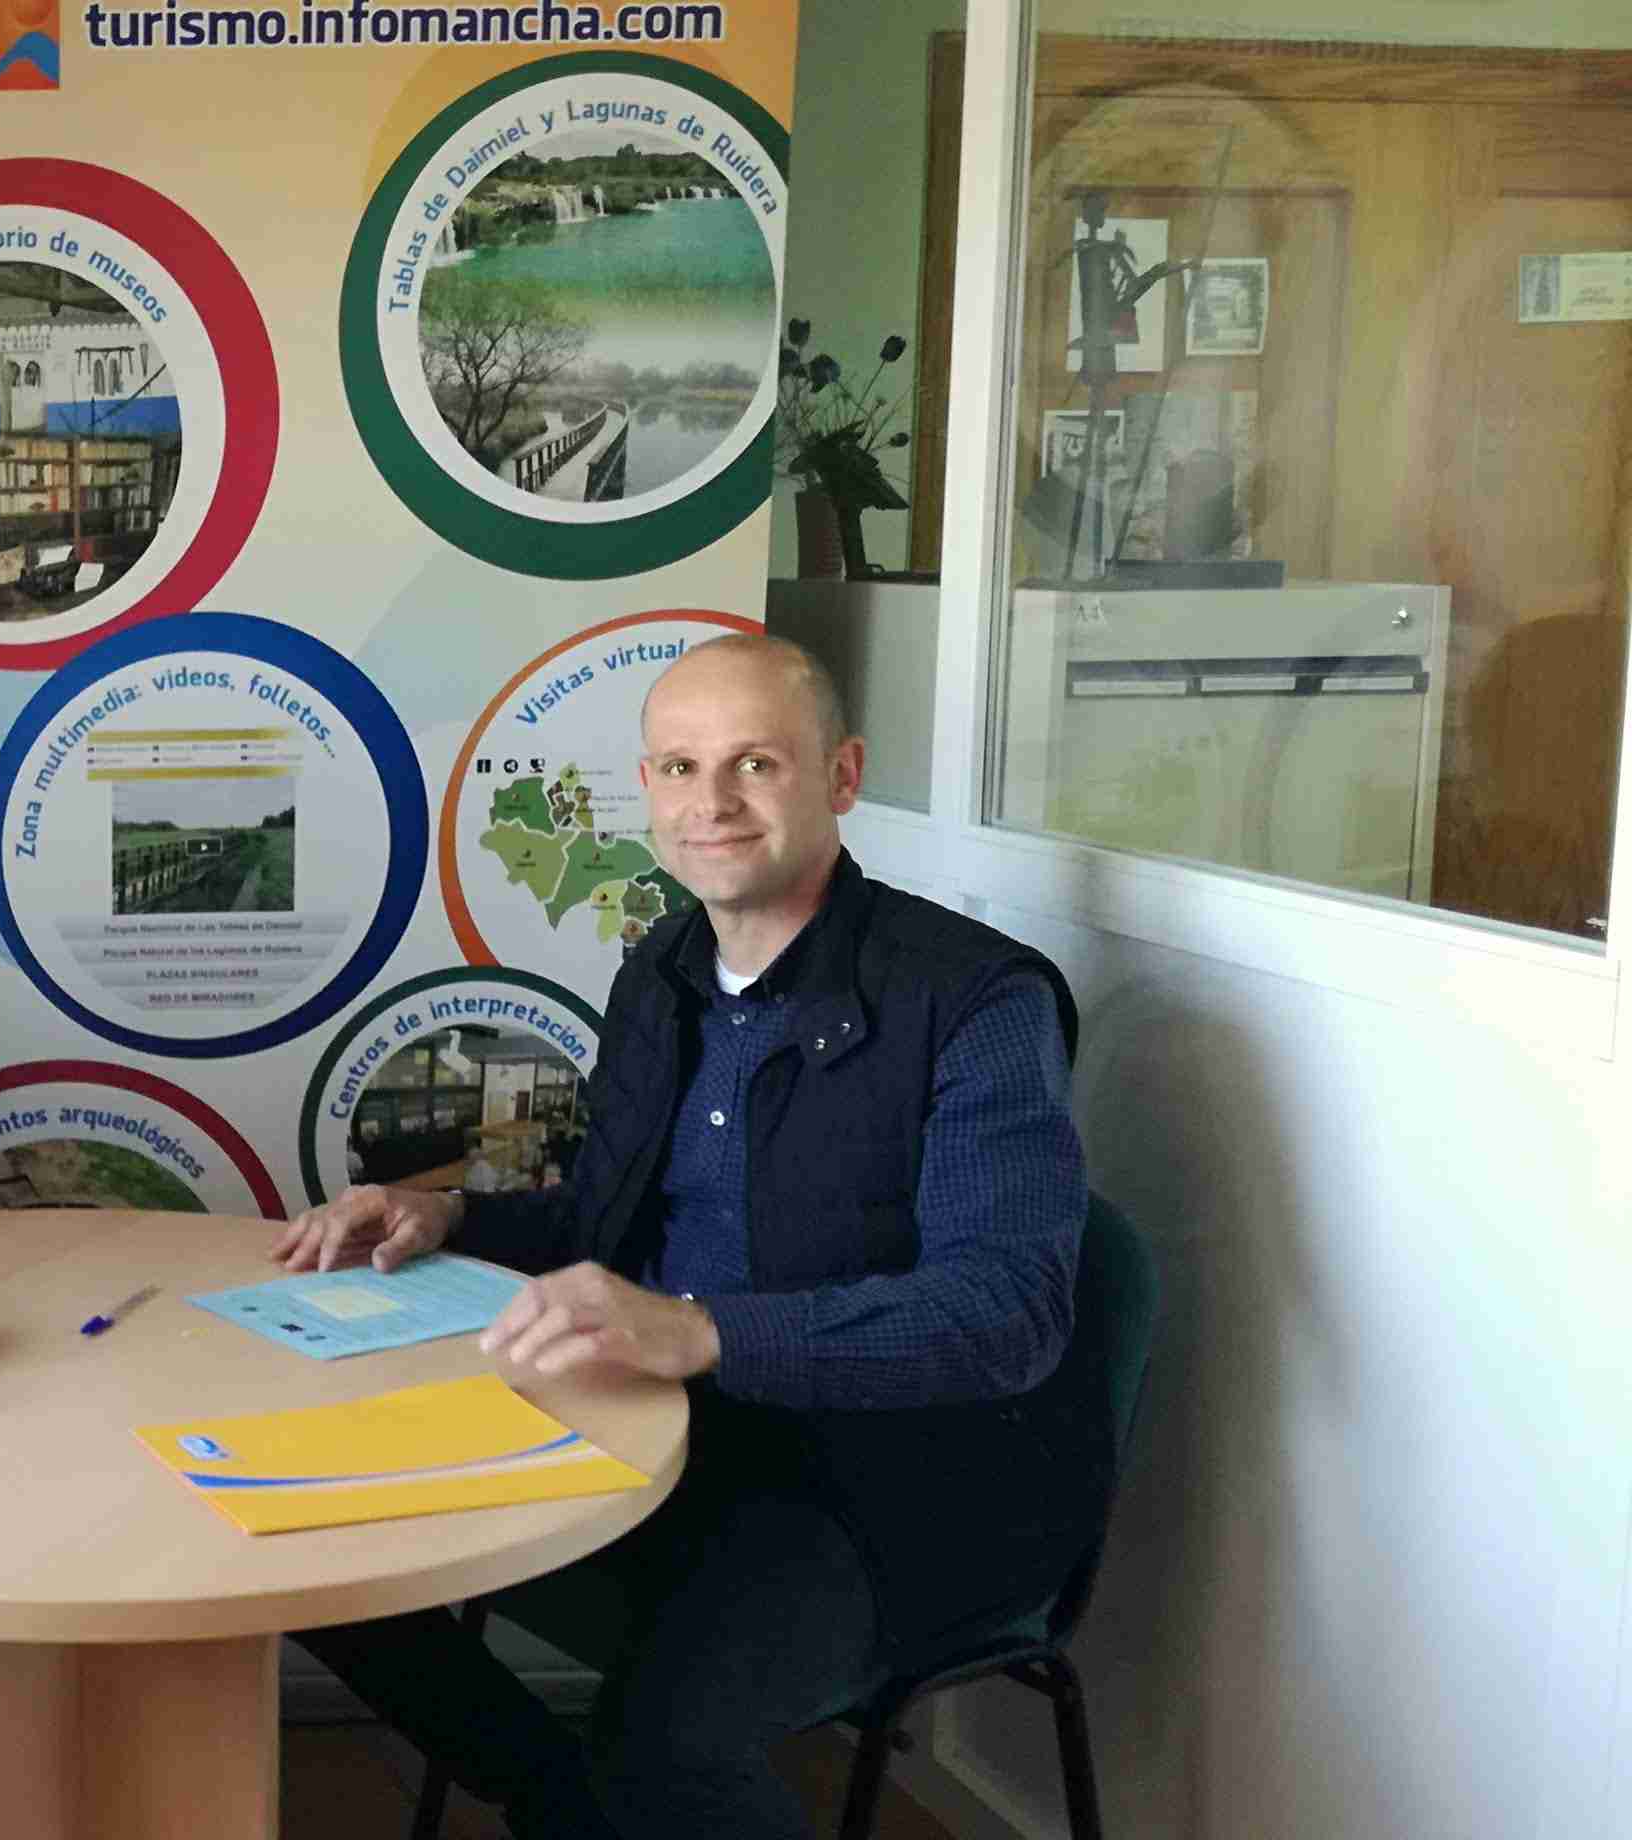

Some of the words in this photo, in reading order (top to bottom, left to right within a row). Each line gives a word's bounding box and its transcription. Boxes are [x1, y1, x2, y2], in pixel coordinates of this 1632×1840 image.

[85, 0, 723, 47] turismo.infomancha.com
[389, 230, 427, 313] Tablas
[423, 192, 449, 222] de
[445, 117, 531, 189] Daimiel
[539, 109, 555, 133] y
[567, 99, 668, 126] Lagunas
[677, 115, 705, 141] de
[710, 131, 778, 217] Ruidera
[49, 231, 79, 257] de
[88, 250, 167, 322] museos
[516, 665, 595, 724] Visitas
[603, 638, 685, 670] virtual
[16, 800, 42, 859] Zona
[34, 684, 142, 792] multimedia:
[249, 673, 335, 759] folletos...
[330, 1036, 390, 1119] Centros
[394, 1012, 422, 1036] de
[429, 996, 587, 1061] interpretación
[59, 1105, 205, 1180] arqueológicos
